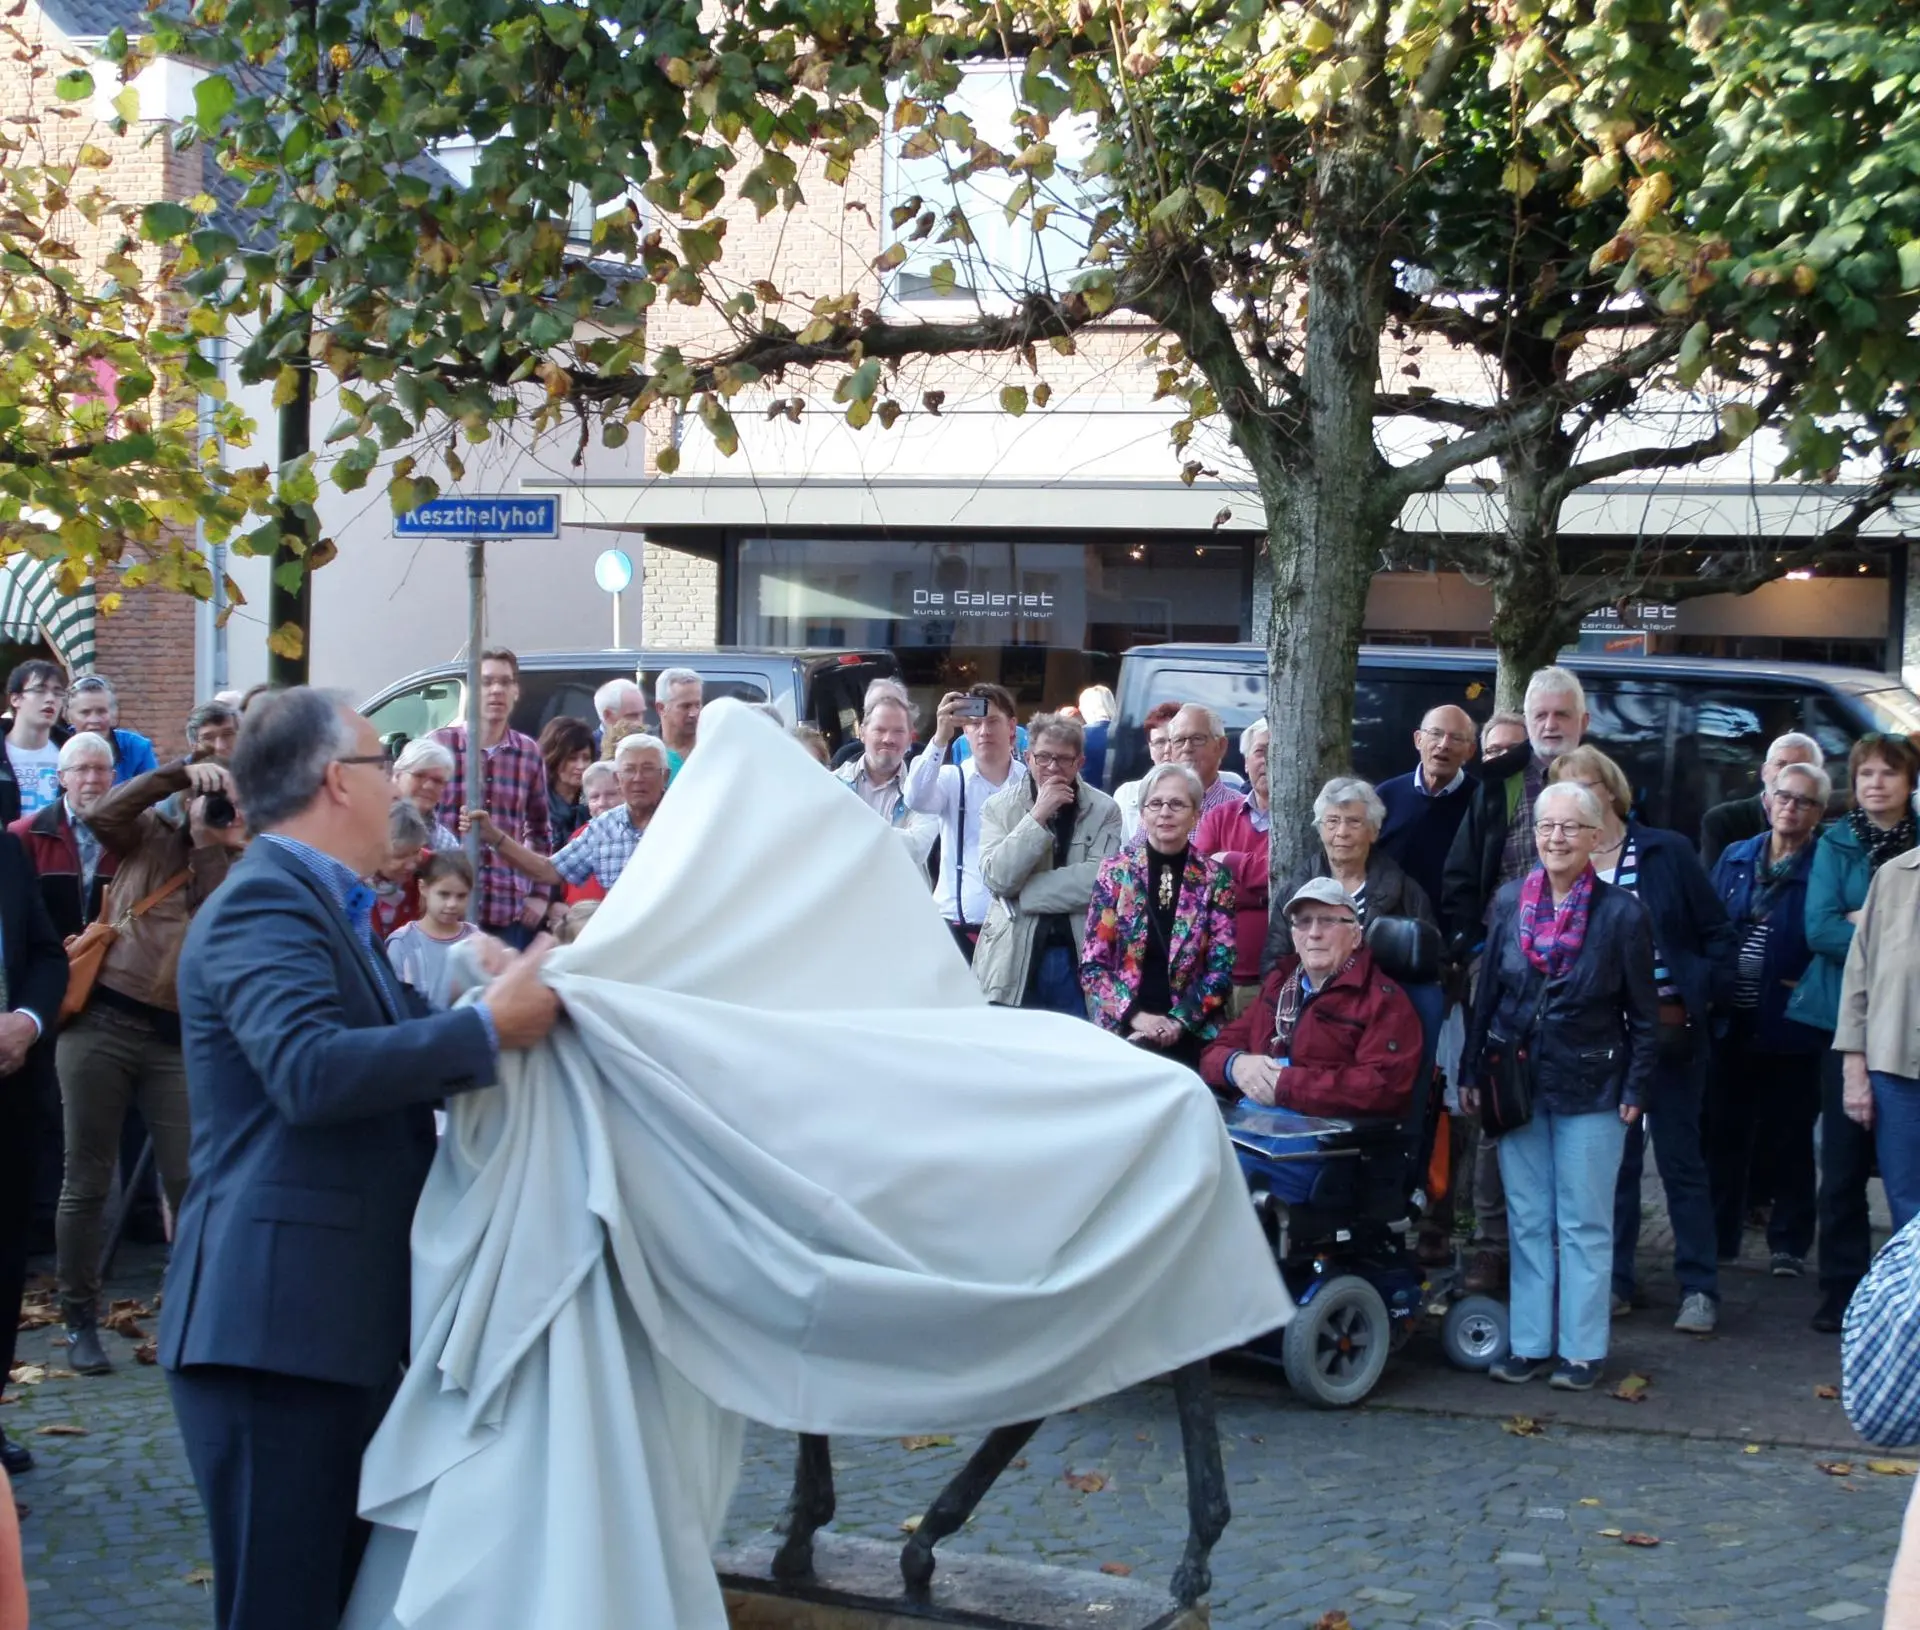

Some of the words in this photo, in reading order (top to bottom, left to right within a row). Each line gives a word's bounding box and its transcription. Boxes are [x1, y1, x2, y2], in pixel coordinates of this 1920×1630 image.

[404, 505, 546, 530] Keszthelyhof
[913, 589, 944, 604] De
[954, 590, 1054, 606] Galeriet
[959, 609, 1010, 618] interieur
[1023, 610, 1054, 618] kleur
[1581, 622, 1625, 630] terieur
[1642, 623, 1677, 631] kleur
